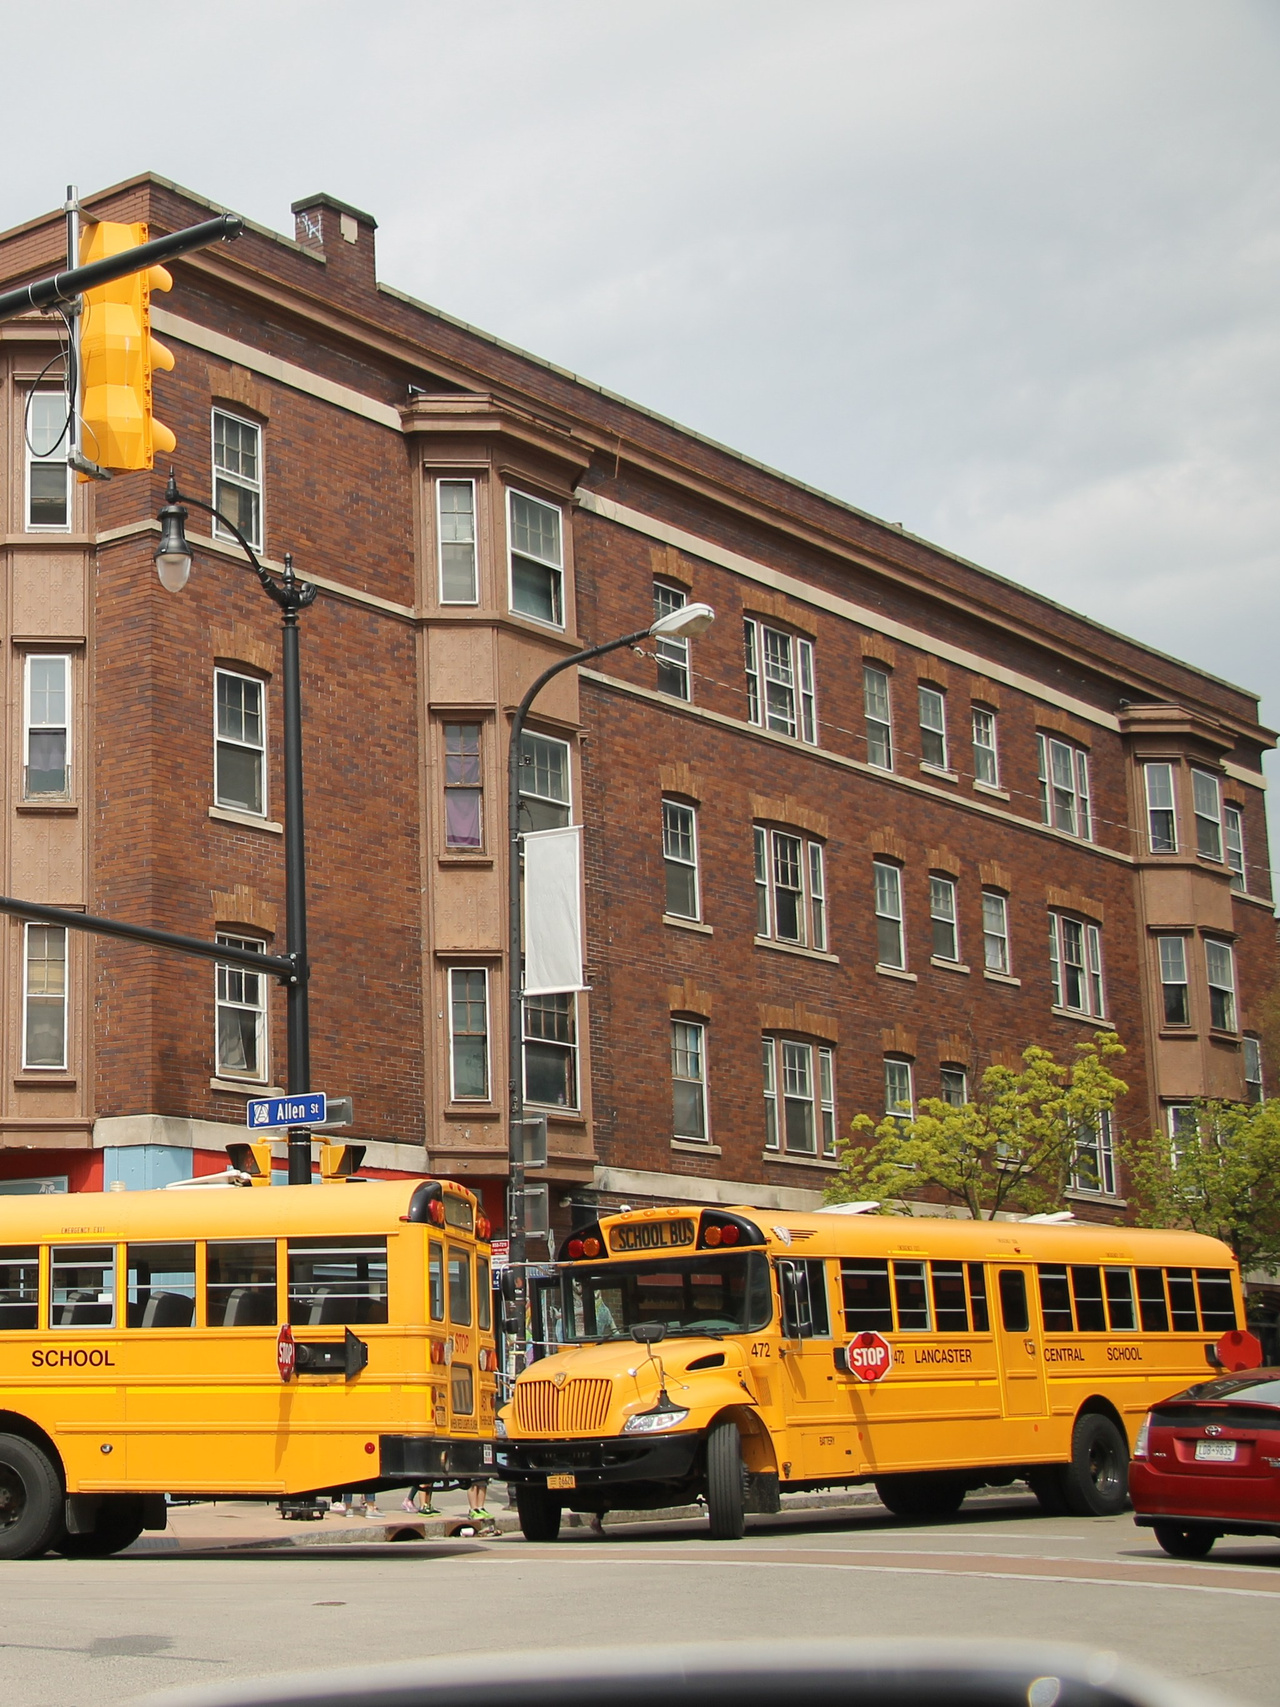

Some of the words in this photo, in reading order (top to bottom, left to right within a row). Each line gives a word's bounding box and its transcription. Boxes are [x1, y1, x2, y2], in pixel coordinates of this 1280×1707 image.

[277, 1102, 305, 1121] Allen
[310, 1103, 319, 1114] St
[619, 1223, 668, 1249] SCHOOL
[670, 1220, 694, 1244] BUS
[31, 1350, 116, 1367] SCHOOL
[278, 1342, 293, 1365] STOP
[751, 1343, 771, 1358] 472
[853, 1347, 885, 1367] STOP
[894, 1350, 905, 1364] 472
[914, 1349, 972, 1364] LANCASTER
[1043, 1348, 1085, 1362] CENTRAL
[1106, 1347, 1143, 1361] SCHOOL
